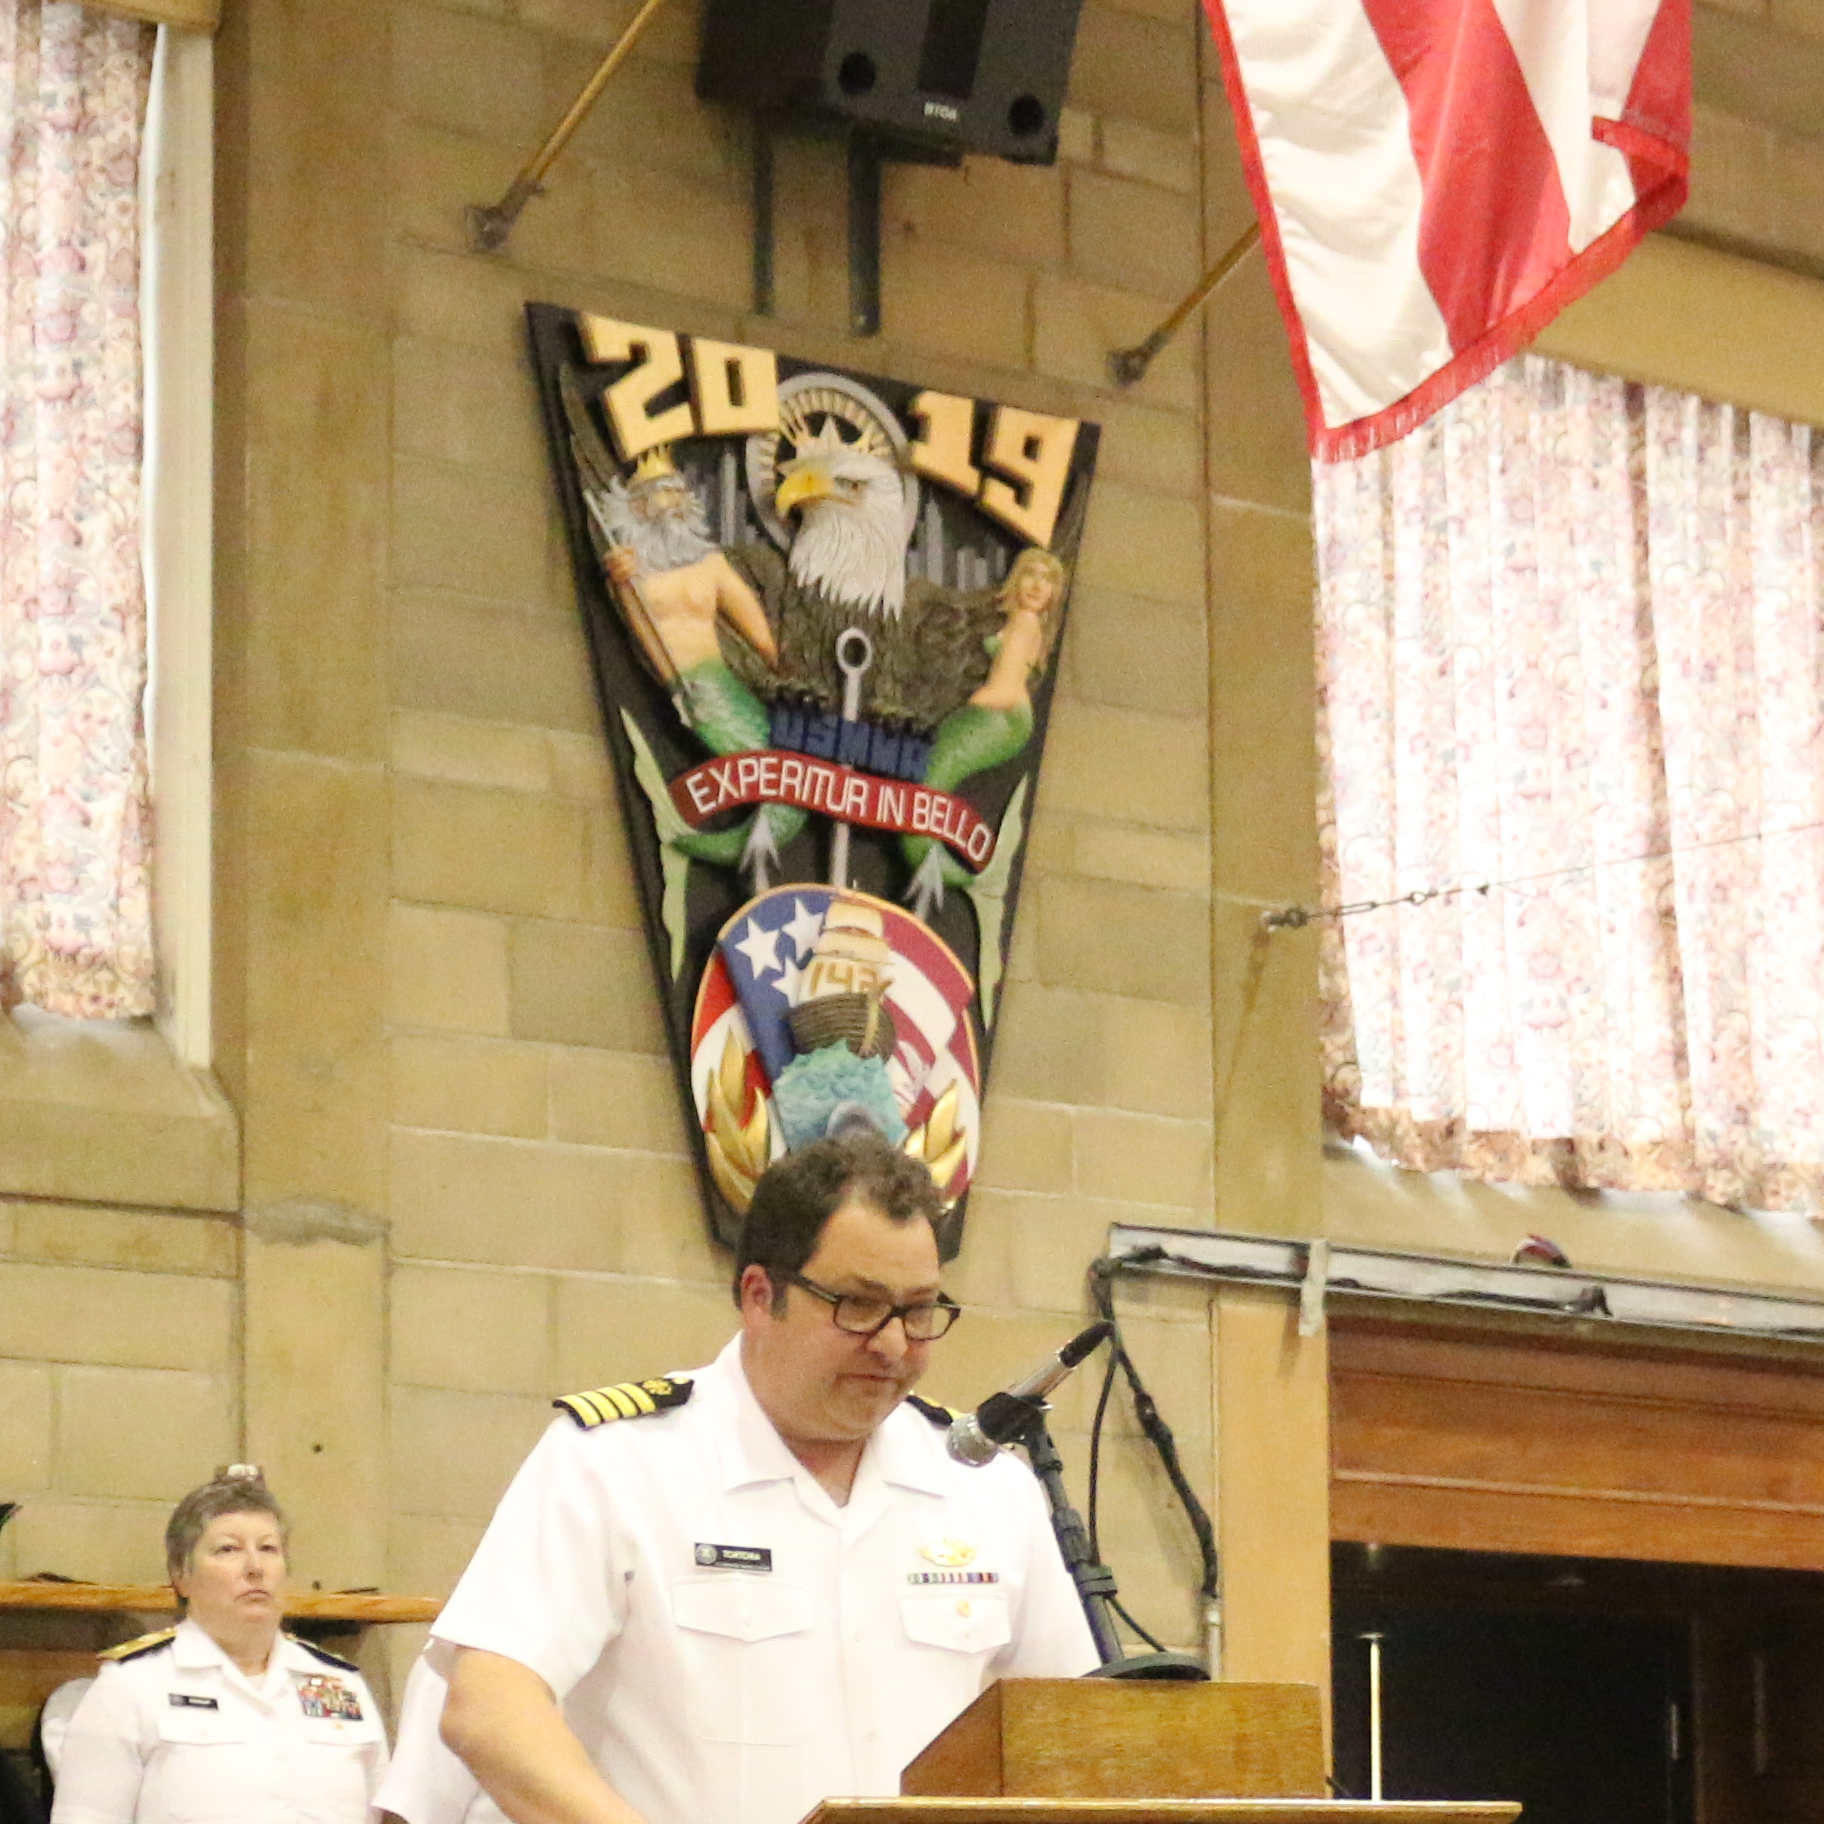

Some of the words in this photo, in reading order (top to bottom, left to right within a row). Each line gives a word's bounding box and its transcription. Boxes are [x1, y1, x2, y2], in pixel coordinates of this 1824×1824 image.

[685, 757, 868, 818] EXPERITUR
[877, 784, 906, 826] IN
[913, 791, 992, 862] BELLO
